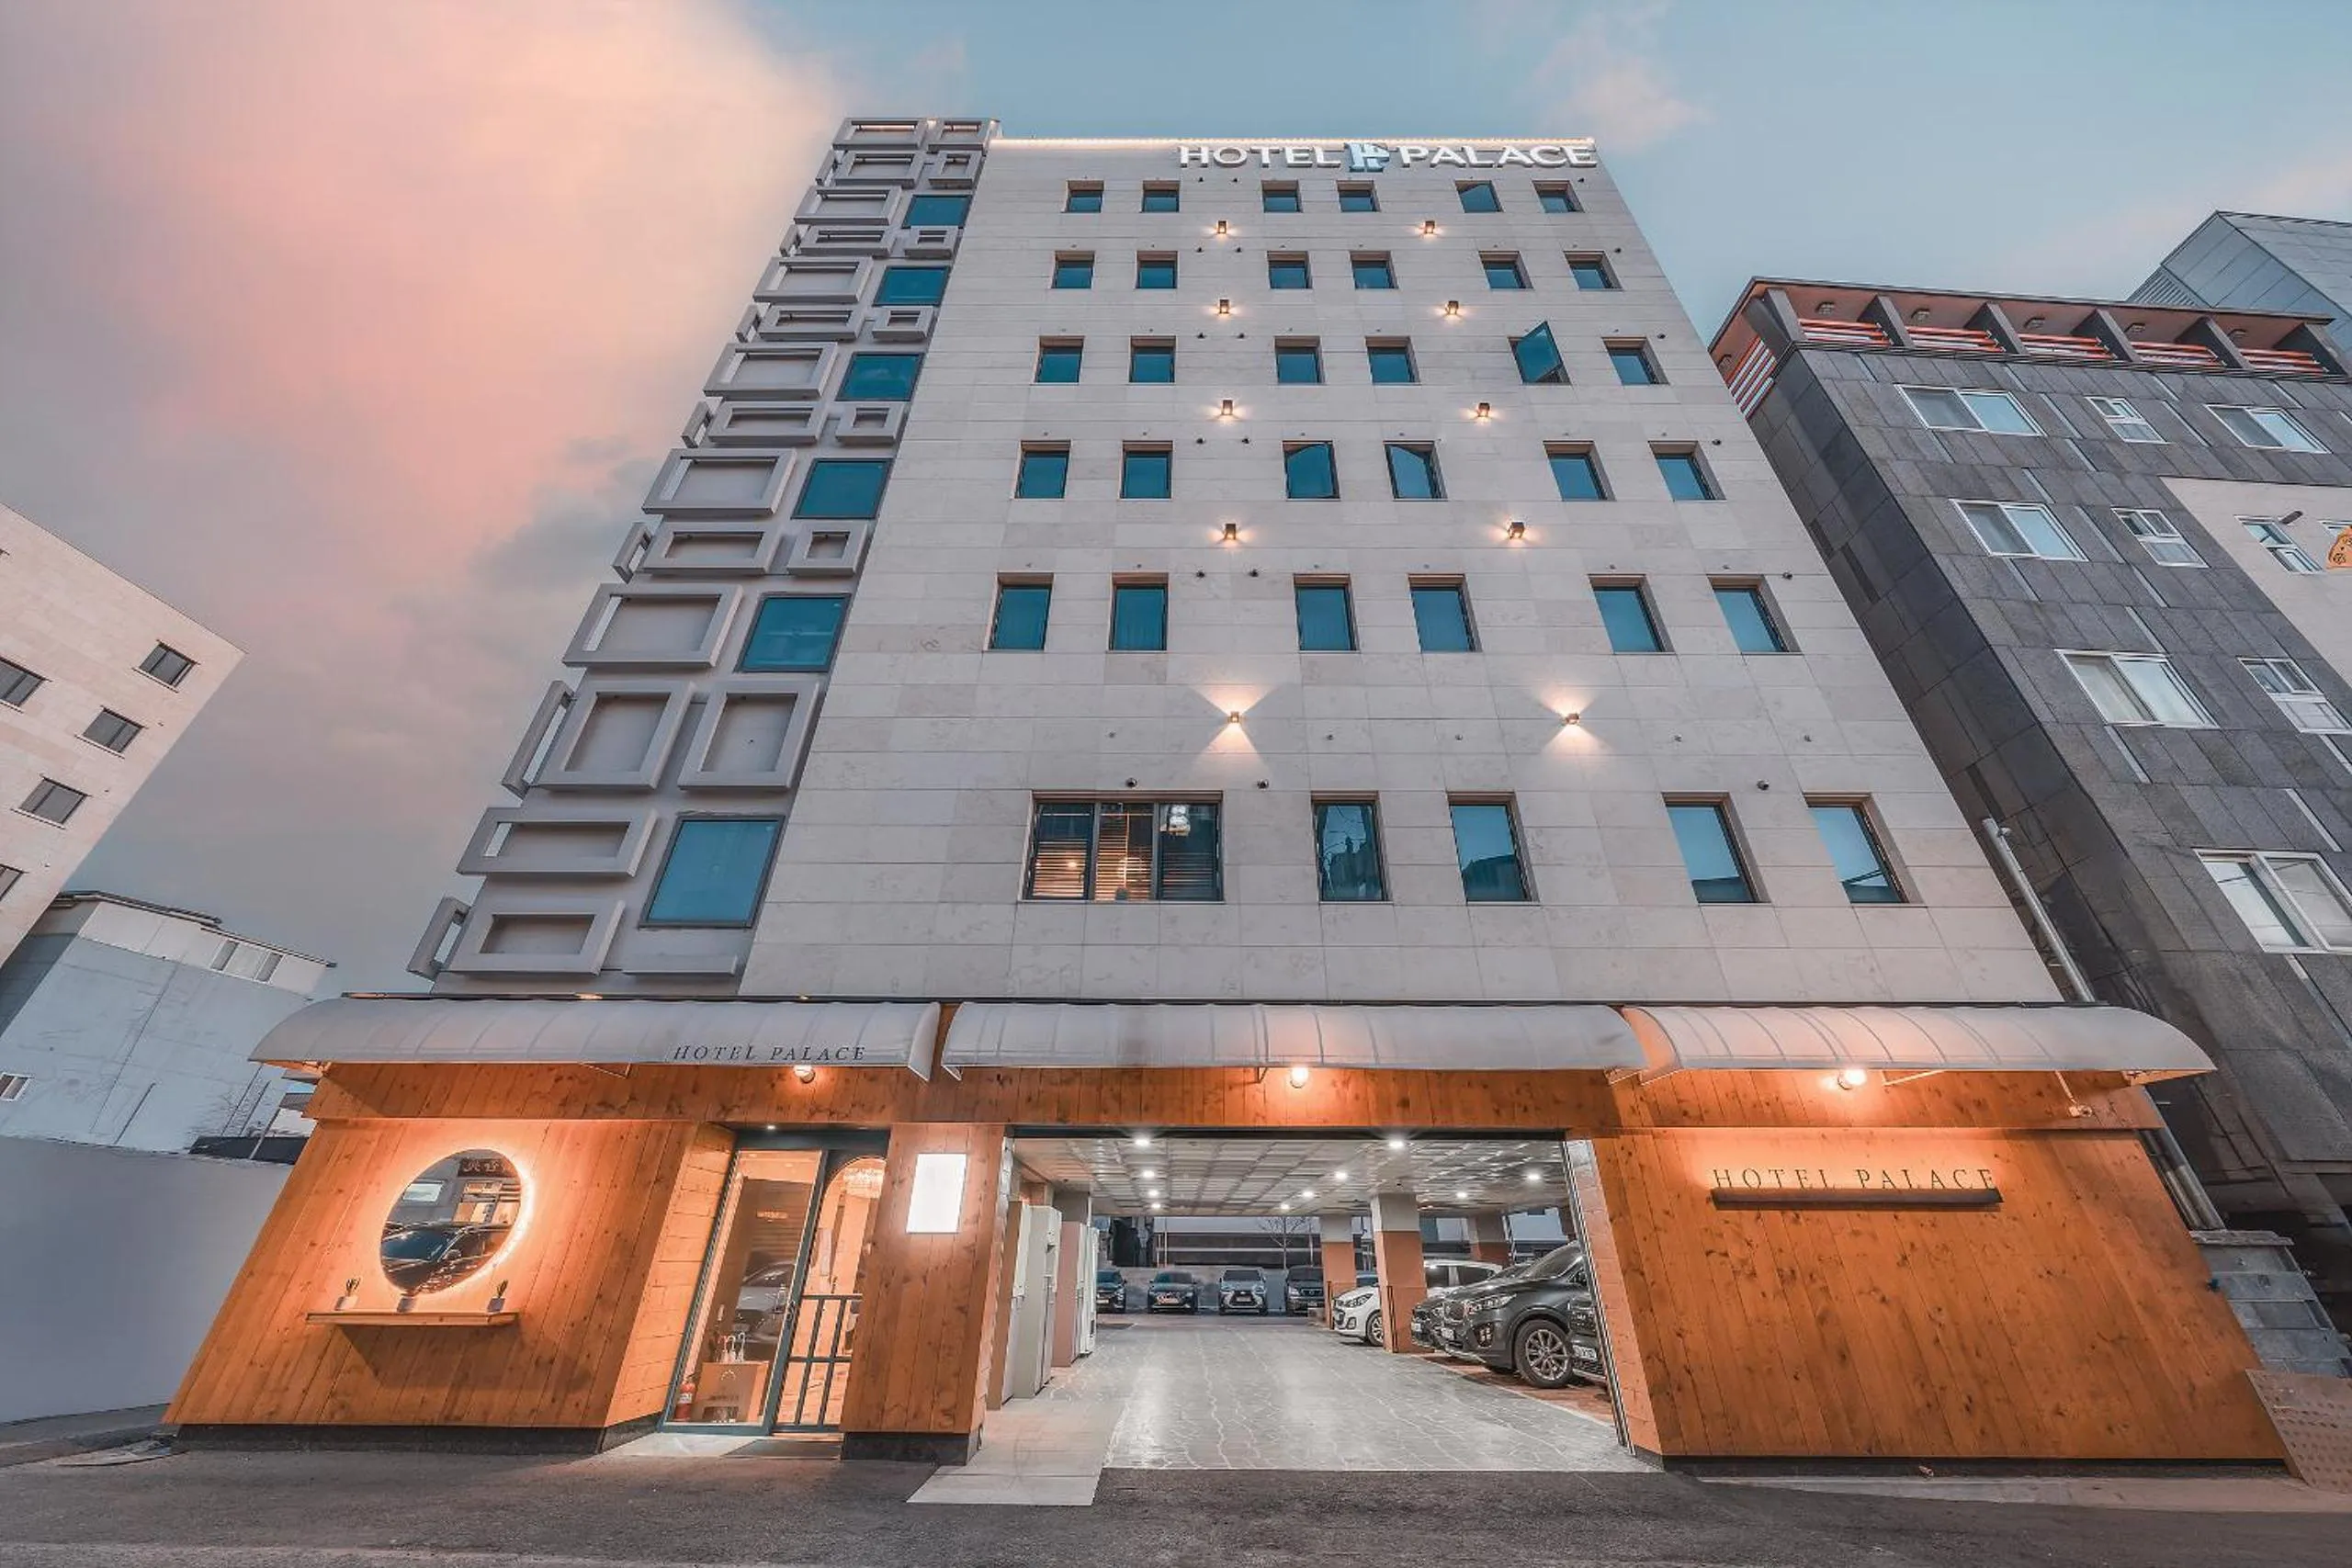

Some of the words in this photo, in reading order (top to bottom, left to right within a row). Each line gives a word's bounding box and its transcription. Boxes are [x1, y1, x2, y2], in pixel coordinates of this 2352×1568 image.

[1180, 145, 1341, 168] HOTEL
[1397, 145, 1598, 168] PALACE
[673, 1045, 755, 1060] HOTEL
[770, 1046, 866, 1061] PALACE
[1713, 1168, 1837, 1189] HOTEL
[1855, 1168, 1995, 1189] PALACE
